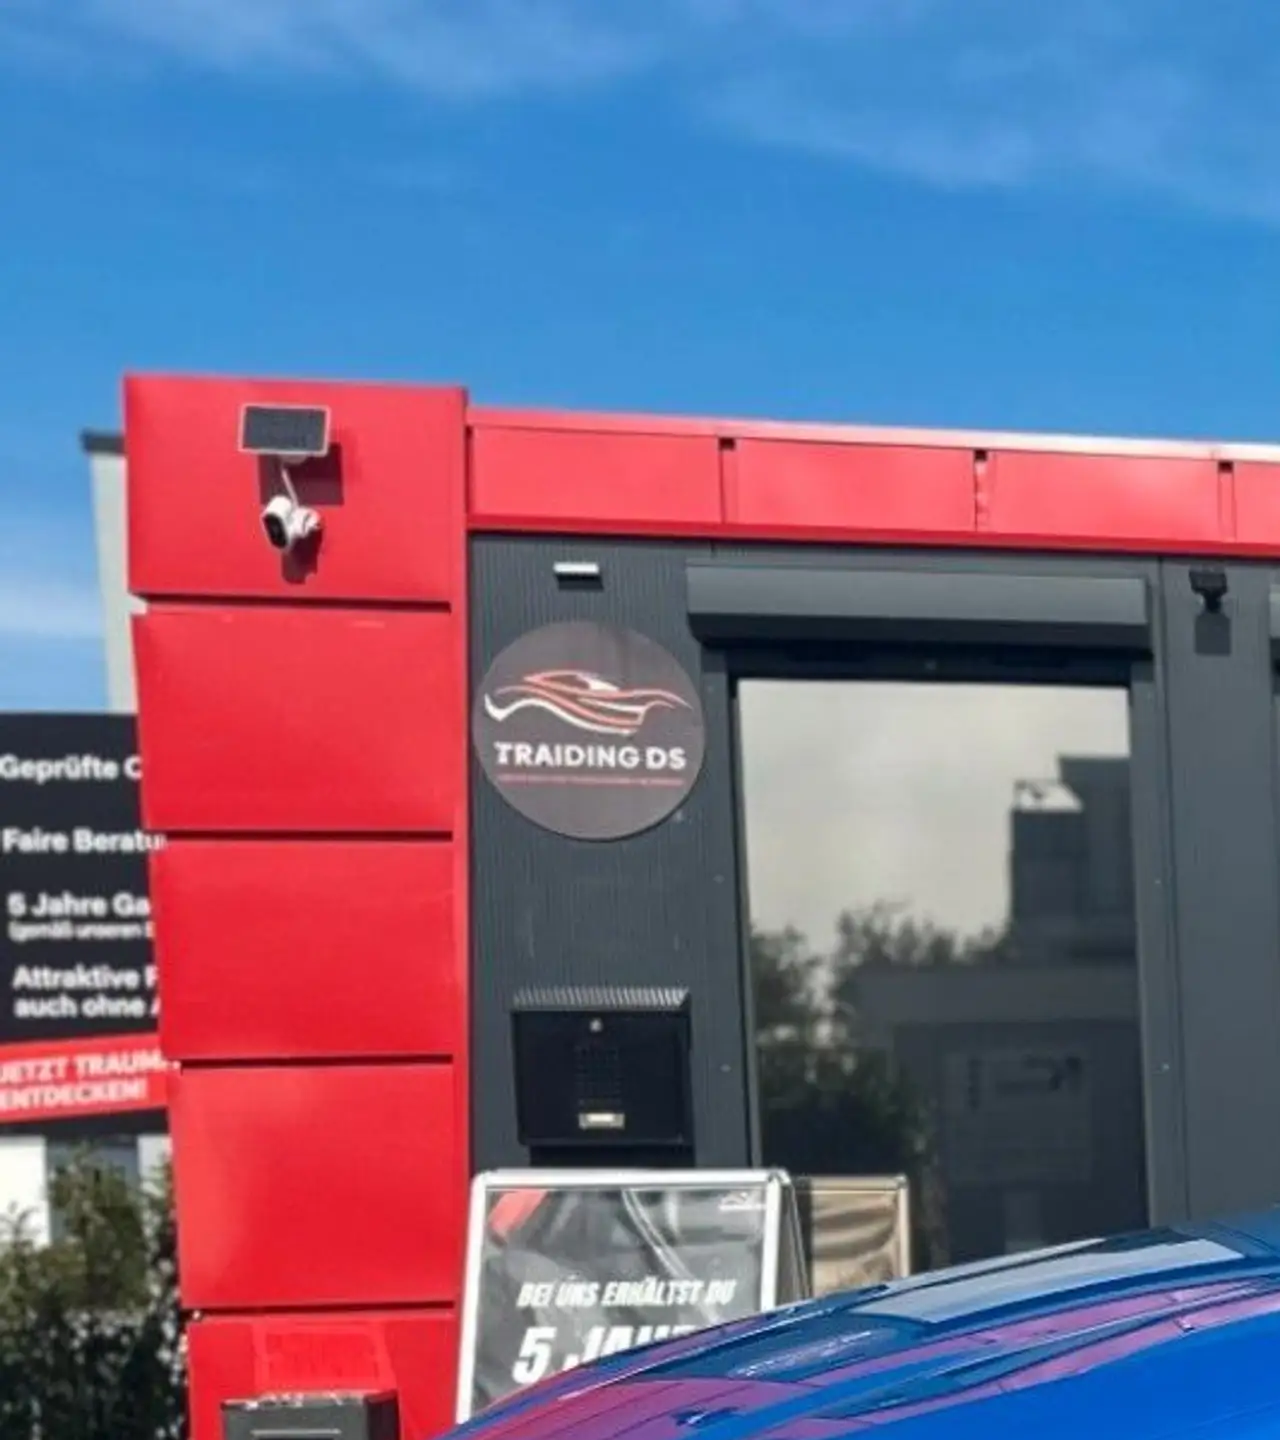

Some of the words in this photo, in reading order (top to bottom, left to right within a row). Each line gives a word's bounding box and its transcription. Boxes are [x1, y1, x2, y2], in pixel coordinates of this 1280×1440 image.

[0, 753, 119, 785] Geprüfte
[494, 741, 640, 769] TRAIDING
[645, 747, 687, 770] DS
[2, 826, 68, 854] Faire
[31, 890, 107, 917] Jahre
[12, 963, 140, 990] Attraktive
[14, 993, 77, 1018] auch
[81, 993, 146, 1018] ohne
[515, 1280, 555, 1308] BEI
[555, 1278, 599, 1307] UNS
[601, 1274, 704, 1307] ERHÄLTST
[705, 1278, 738, 1305] DU
[511, 1326, 557, 1384] 5
